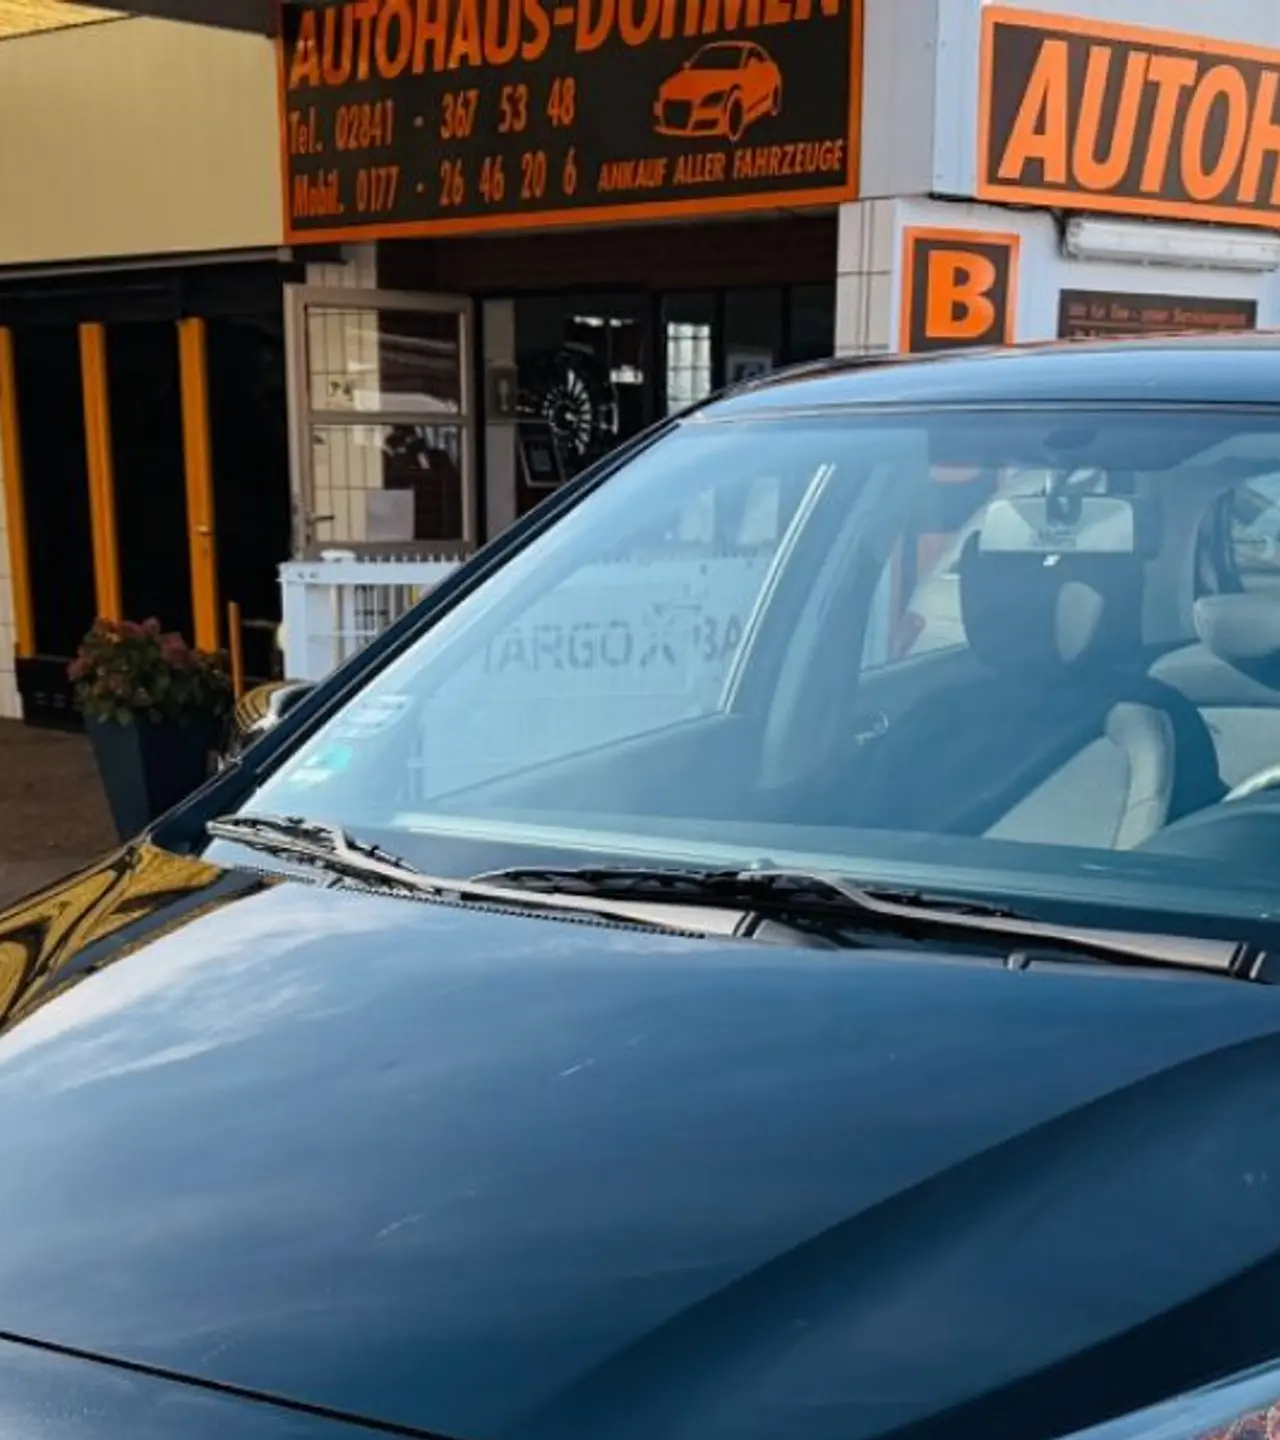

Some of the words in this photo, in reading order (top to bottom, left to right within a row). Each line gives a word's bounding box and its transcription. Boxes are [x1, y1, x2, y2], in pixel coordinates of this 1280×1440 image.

[288, 0, 839, 89] AUTOHAUS-DO
[288, 105, 324, 155] Tel.
[334, 100, 394, 151] 02841
[440, 88, 479, 140] 367
[498, 83, 528, 133] 53
[547, 76, 576, 127] 48
[294, 167, 345, 216] Mobil.
[356, 165, 400, 213] 0177
[440, 158, 465, 207] 26
[479, 154, 505, 202] 46
[521, 150, 547, 200] 20
[562, 145, 577, 196] 6
[597, 157, 668, 194] ANKAUF
[672, 151, 726, 187] ALLER
[732, 139, 845, 181] FAHRZEUGE
[928, 249, 997, 338] B
